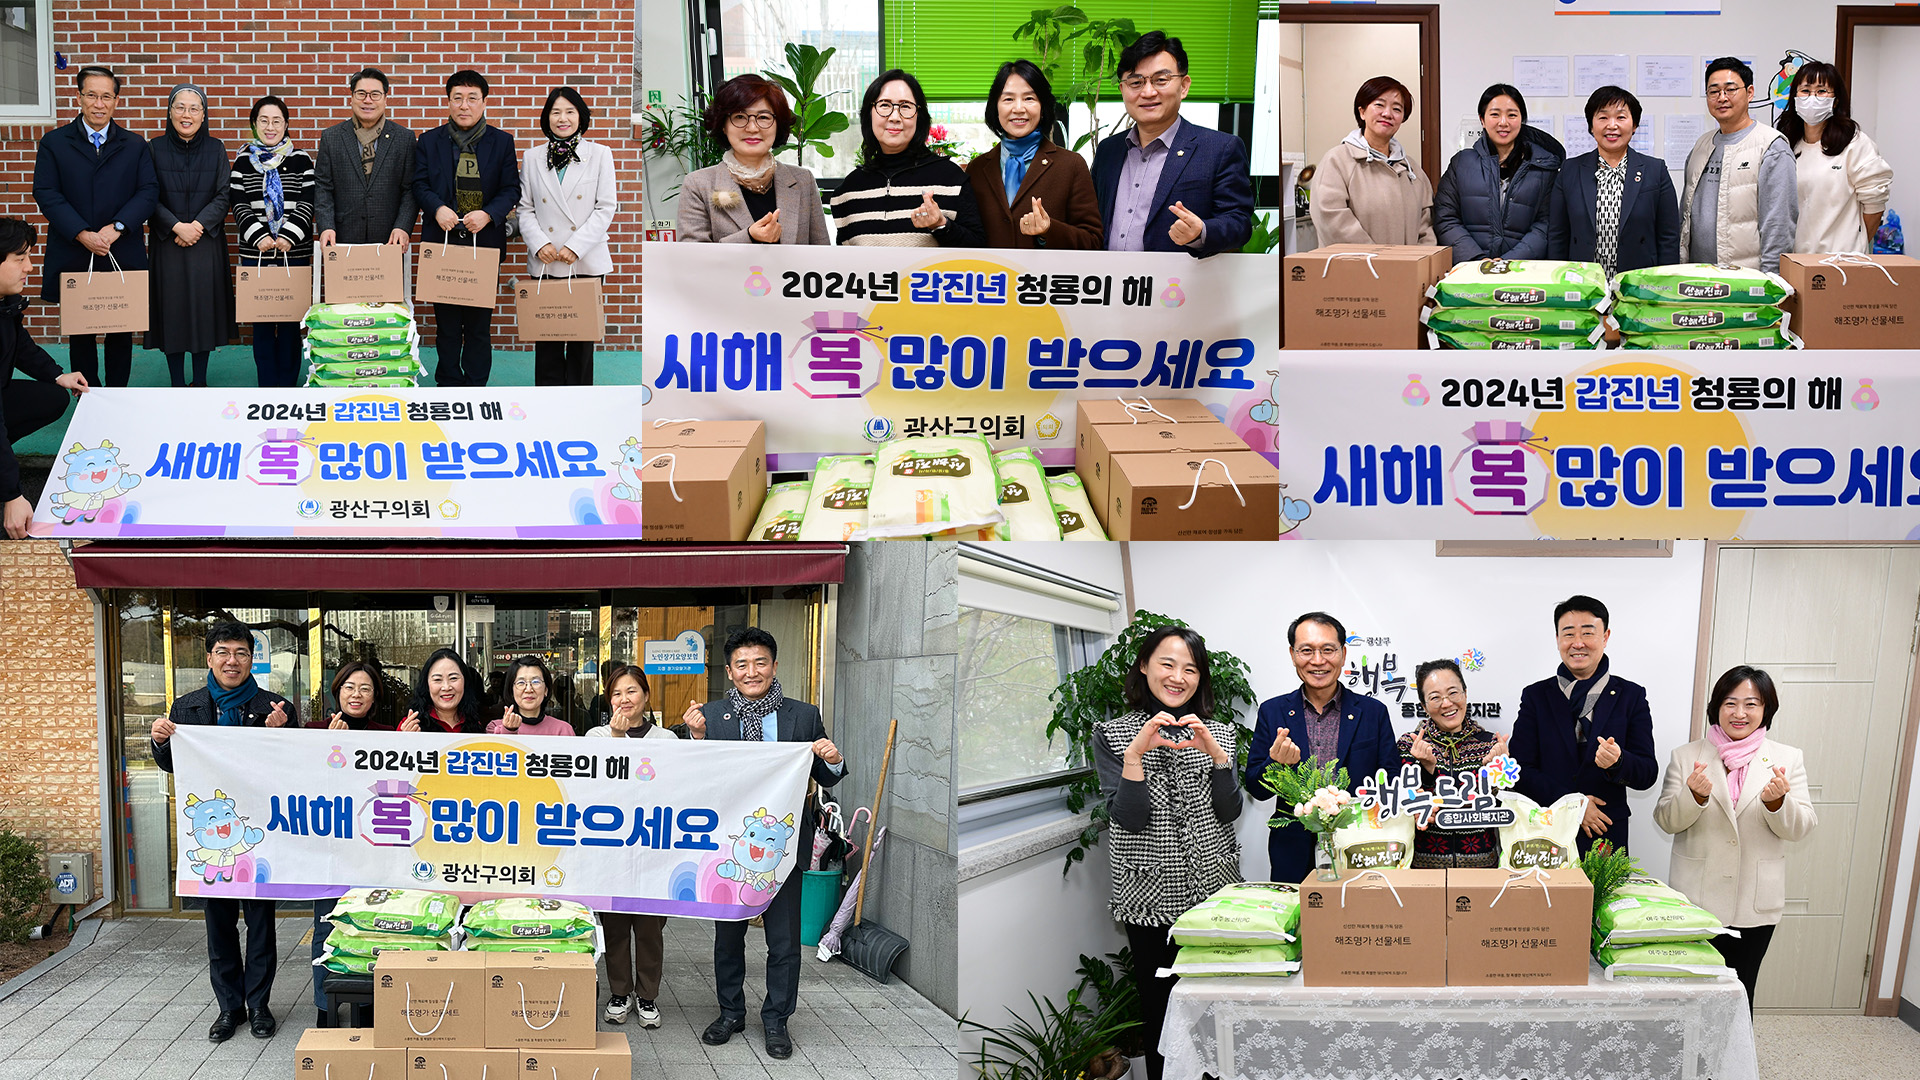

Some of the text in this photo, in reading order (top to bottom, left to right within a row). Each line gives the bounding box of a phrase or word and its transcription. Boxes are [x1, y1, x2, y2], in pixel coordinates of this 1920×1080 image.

[782, 270, 1153, 307] 2024년 갑진년 청룡의 해
[1685, 286, 1723, 297] 산해진미
[1500, 292, 1539, 303] 산해진미
[1315, 308, 1387, 319] 해조명가 선물세트
[1678, 316, 1717, 326] 산해진미
[1834, 315, 1905, 326] 해조명가 선물세트
[1495, 320, 1534, 331] 산해진미
[654, 332, 1256, 393] 새해 복 많이 받으세요
[1441, 376, 1843, 411] 2024년 갑진년 청룡의 해
[246, 402, 503, 421] 2024년 갑진년 청룡의 해
[145, 440, 607, 481] 새해 복 많이 받으세요
[1313, 444, 1444, 507] 새해
[1471, 448, 1528, 506] 복
[1556, 444, 1683, 508] 많이
[329, 499, 431, 519] 광산구의회
[1366, 637, 1392, 647] 광산구
[651, 653, 699, 661] 노인장기요양보험
[354, 750, 630, 780] 2024년 갑진년 청룡의 해
[1358, 766, 1493, 825] 행복드림
[266, 794, 720, 851] 새해 복 많이 받으세요
[1443, 811, 1510, 824] 종합사회복지관
[1351, 851, 1403, 868] 산해진미
[1513, 849, 1563, 867] 산해진미
[441, 863, 536, 886] 광산구의회
[58, 878, 75, 889] ADT
[1334, 936, 1412, 947] 해조명가 선물세트
[1481, 938, 1558, 949] 해조명가 선물세트
